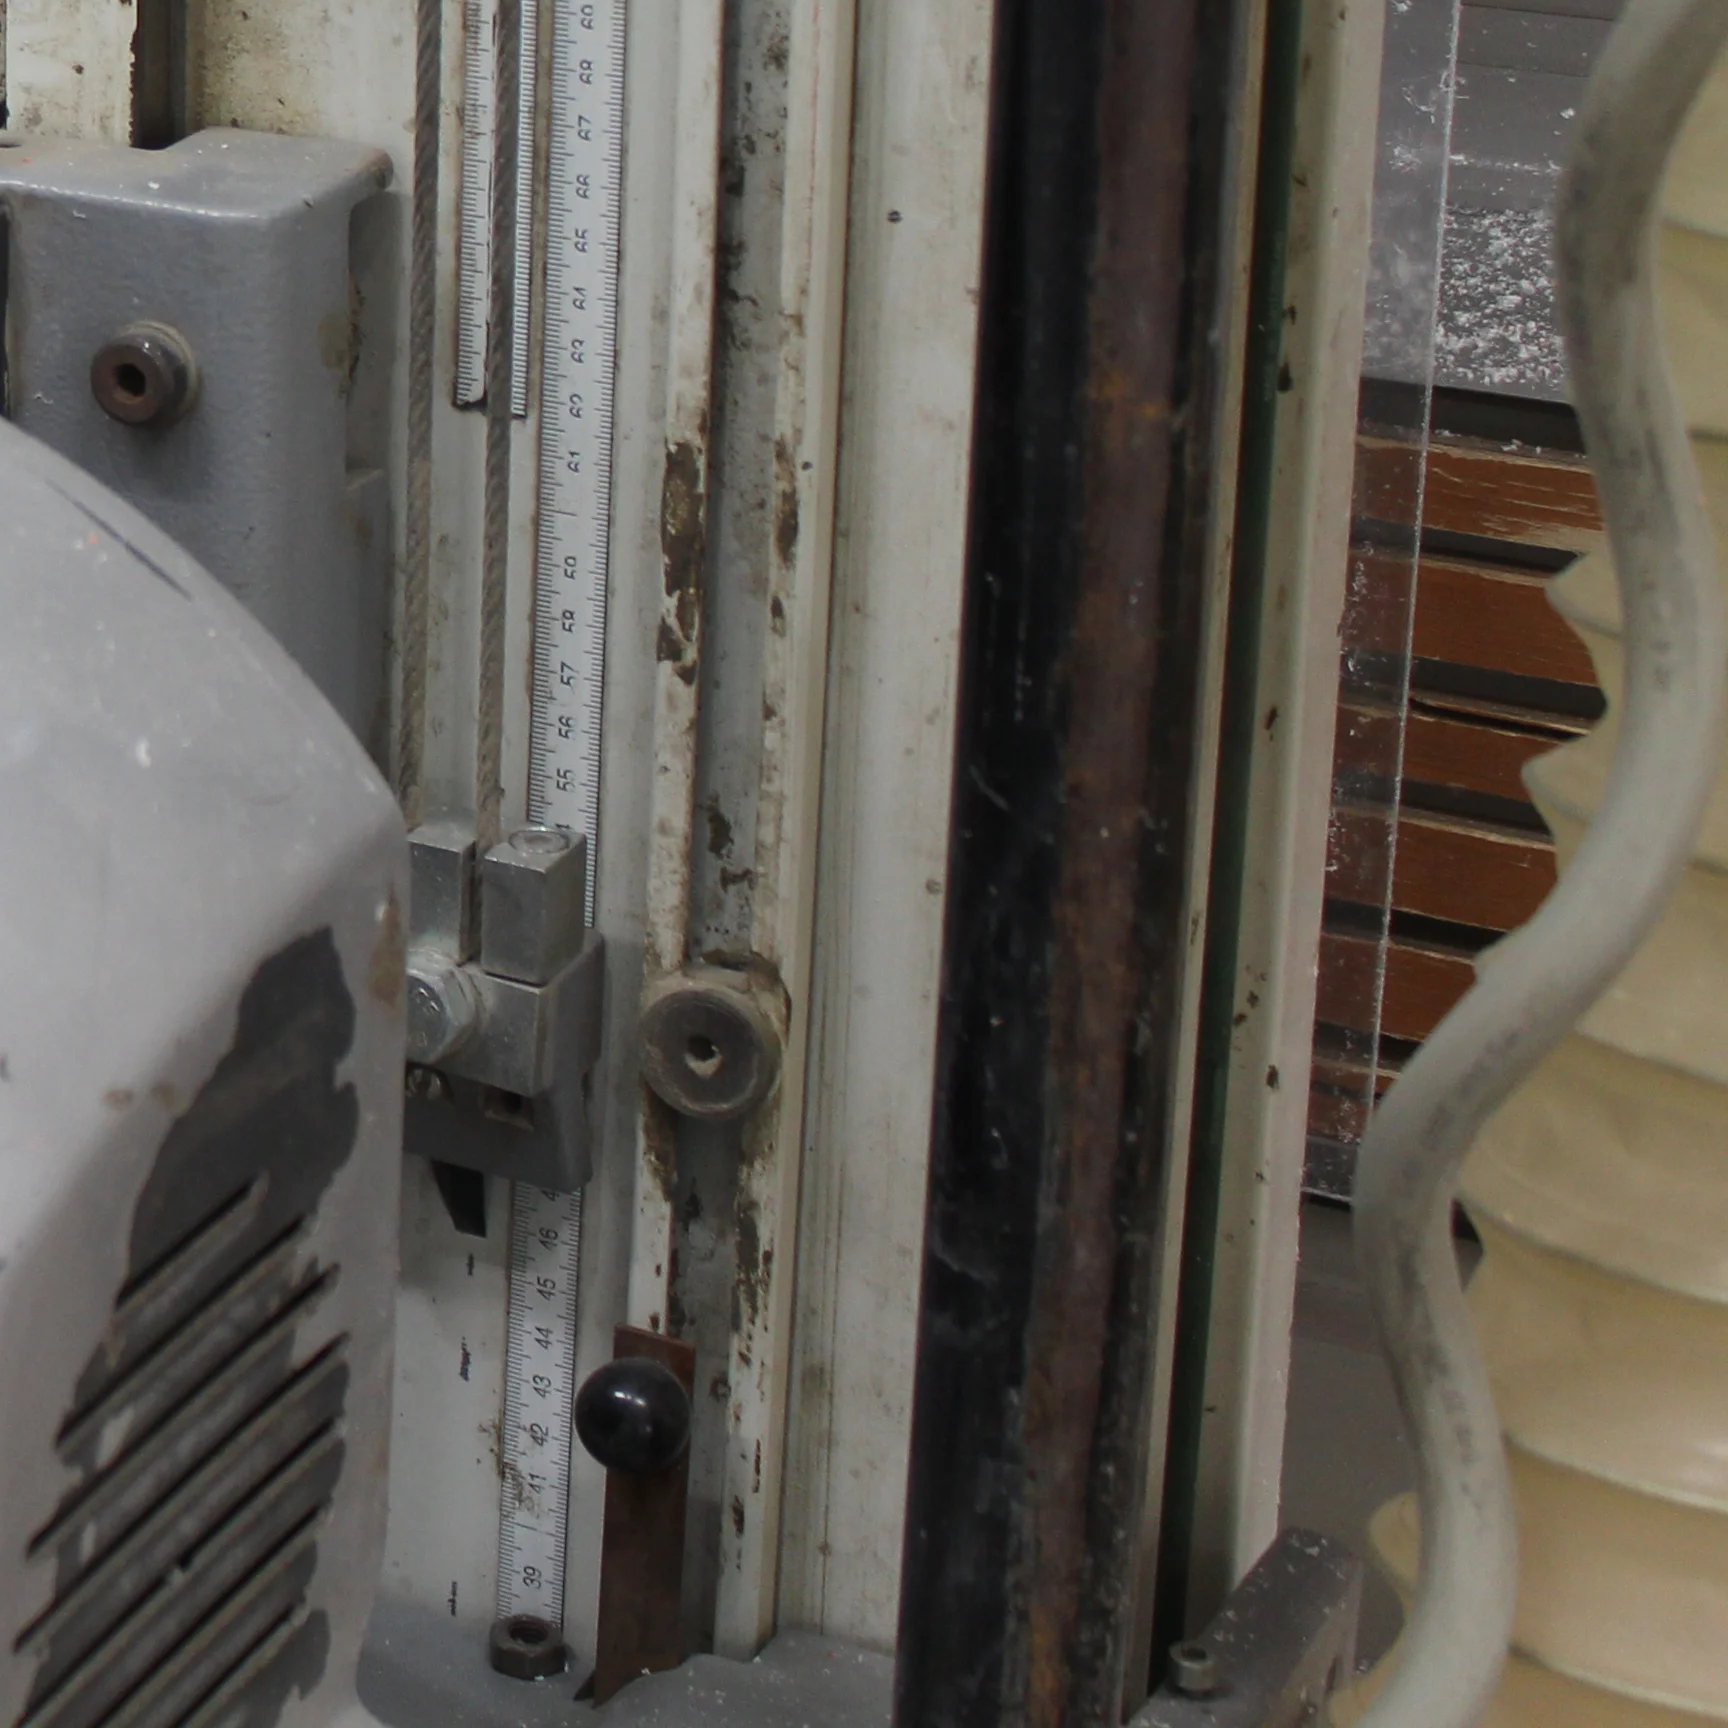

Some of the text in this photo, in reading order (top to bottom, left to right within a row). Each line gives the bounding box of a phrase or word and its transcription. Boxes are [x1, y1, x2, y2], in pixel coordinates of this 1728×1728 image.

[559, 662, 578, 687] 57
[558, 715, 576, 739] 56
[556, 768, 574, 792] 55
[539, 1228, 558, 1251] 46
[536, 1276, 556, 1301] 45
[534, 1325, 552, 1350] 44
[532, 1374, 551, 1398] 43
[530, 1423, 549, 1446] 42
[528, 1474, 544, 1494] 41
[523, 1566, 541, 1589] 39
